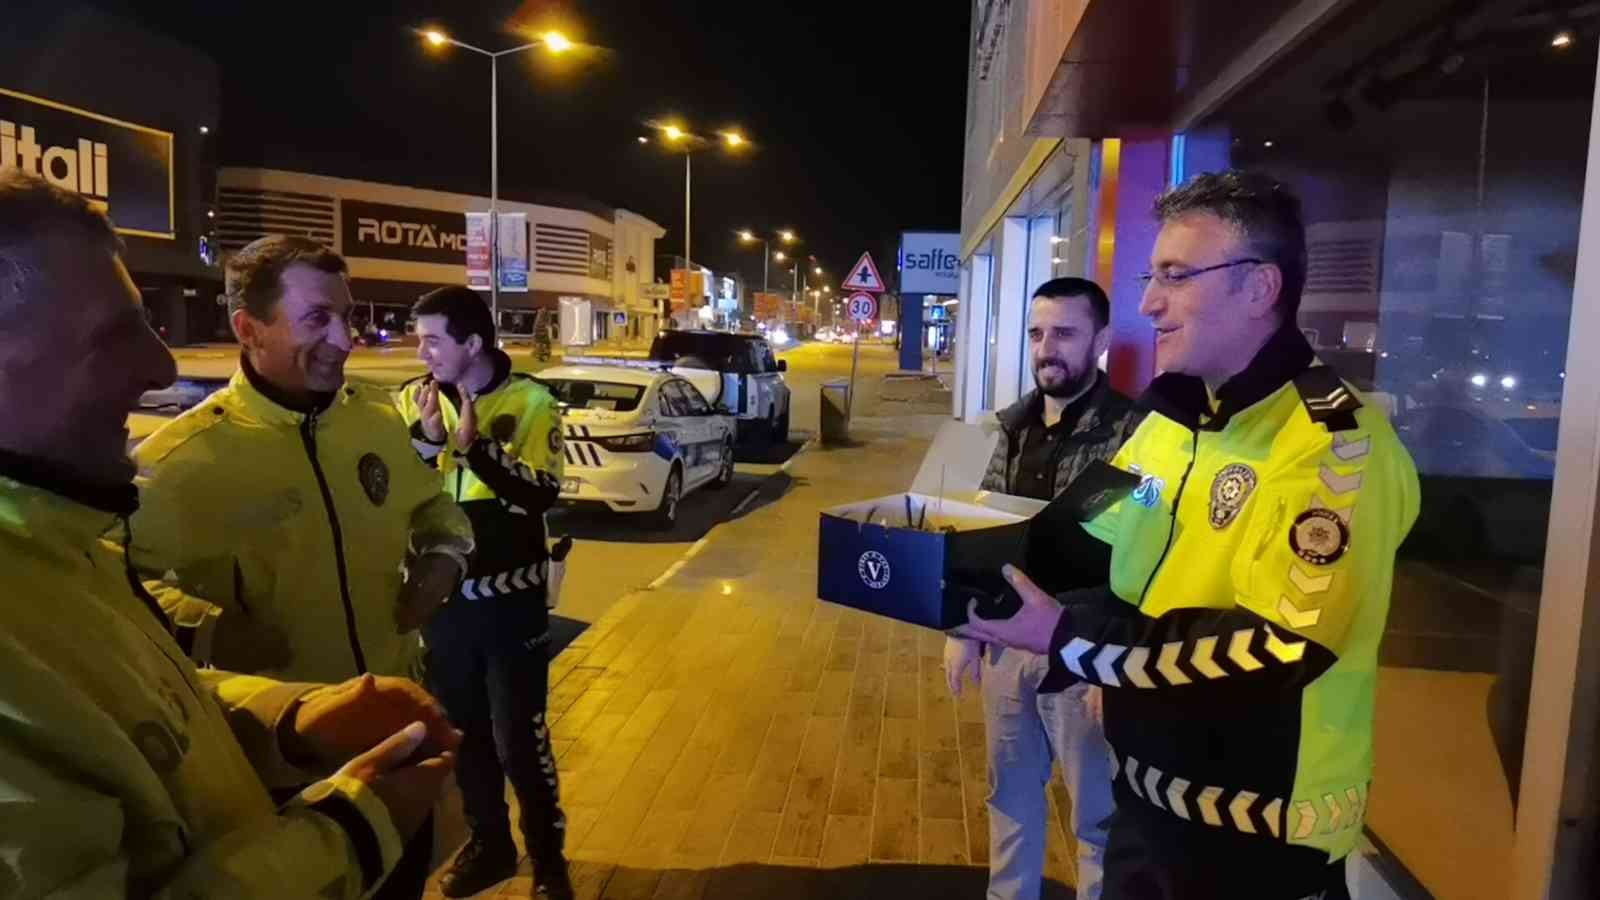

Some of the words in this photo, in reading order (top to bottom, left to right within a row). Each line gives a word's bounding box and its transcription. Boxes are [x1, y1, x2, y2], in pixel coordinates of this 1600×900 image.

[358, 218, 438, 248] ROTA
[905, 248, 961, 270] saffe
[852, 300, 871, 315] 30
[867, 561, 881, 580] V
